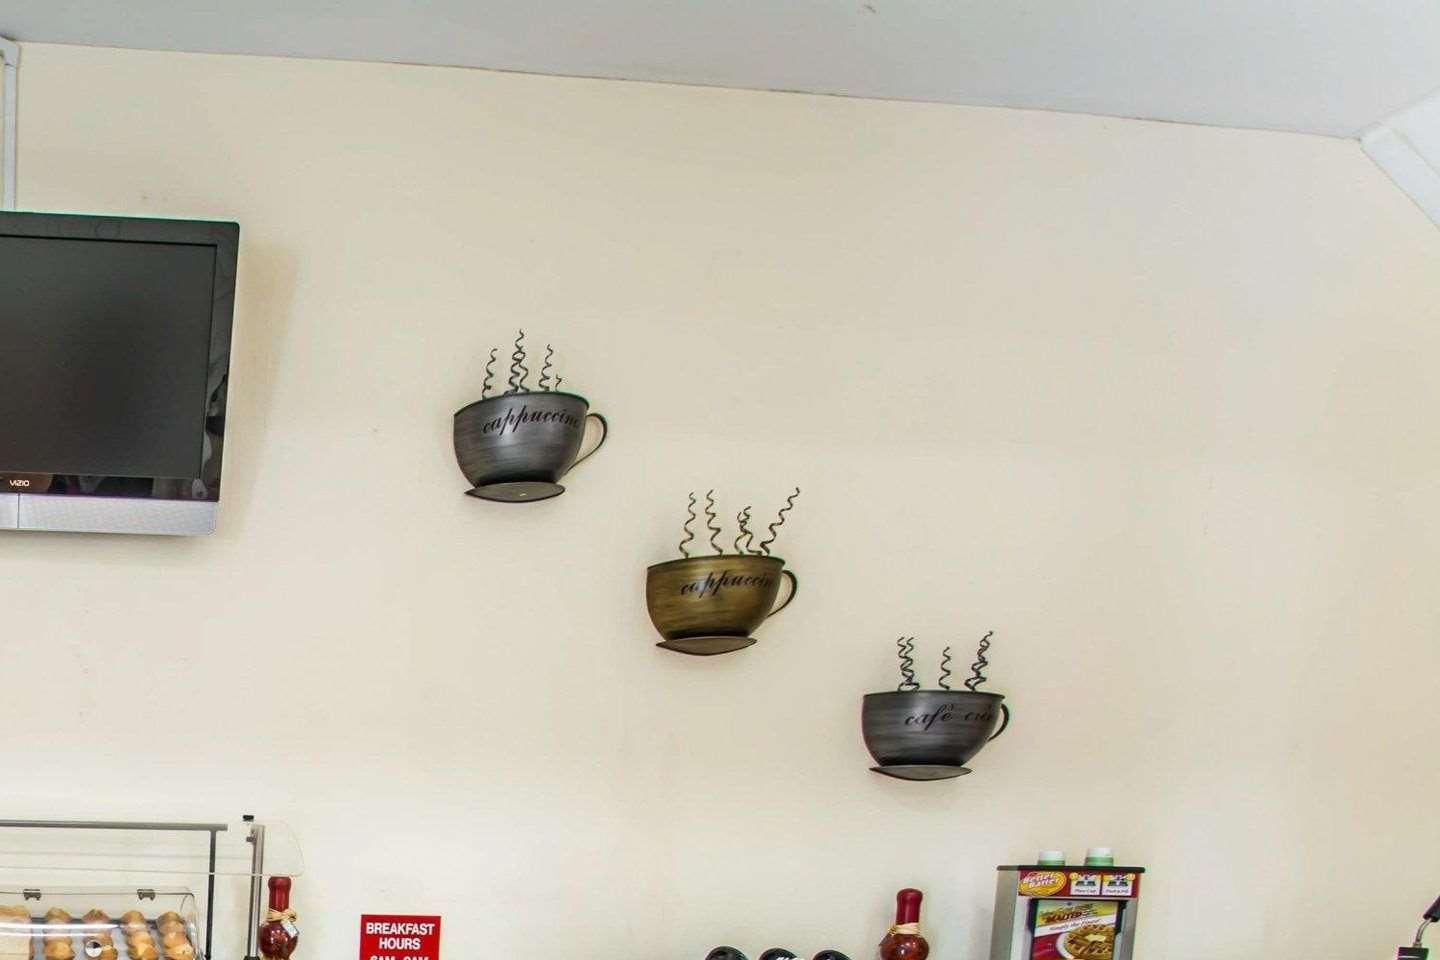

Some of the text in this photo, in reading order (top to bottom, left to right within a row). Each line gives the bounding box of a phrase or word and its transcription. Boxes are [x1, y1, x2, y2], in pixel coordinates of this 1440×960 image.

[9, 479, 30, 487] VIZIO
[365, 922, 435, 936] BREAKFAST
[378, 937, 422, 950] HOURS
